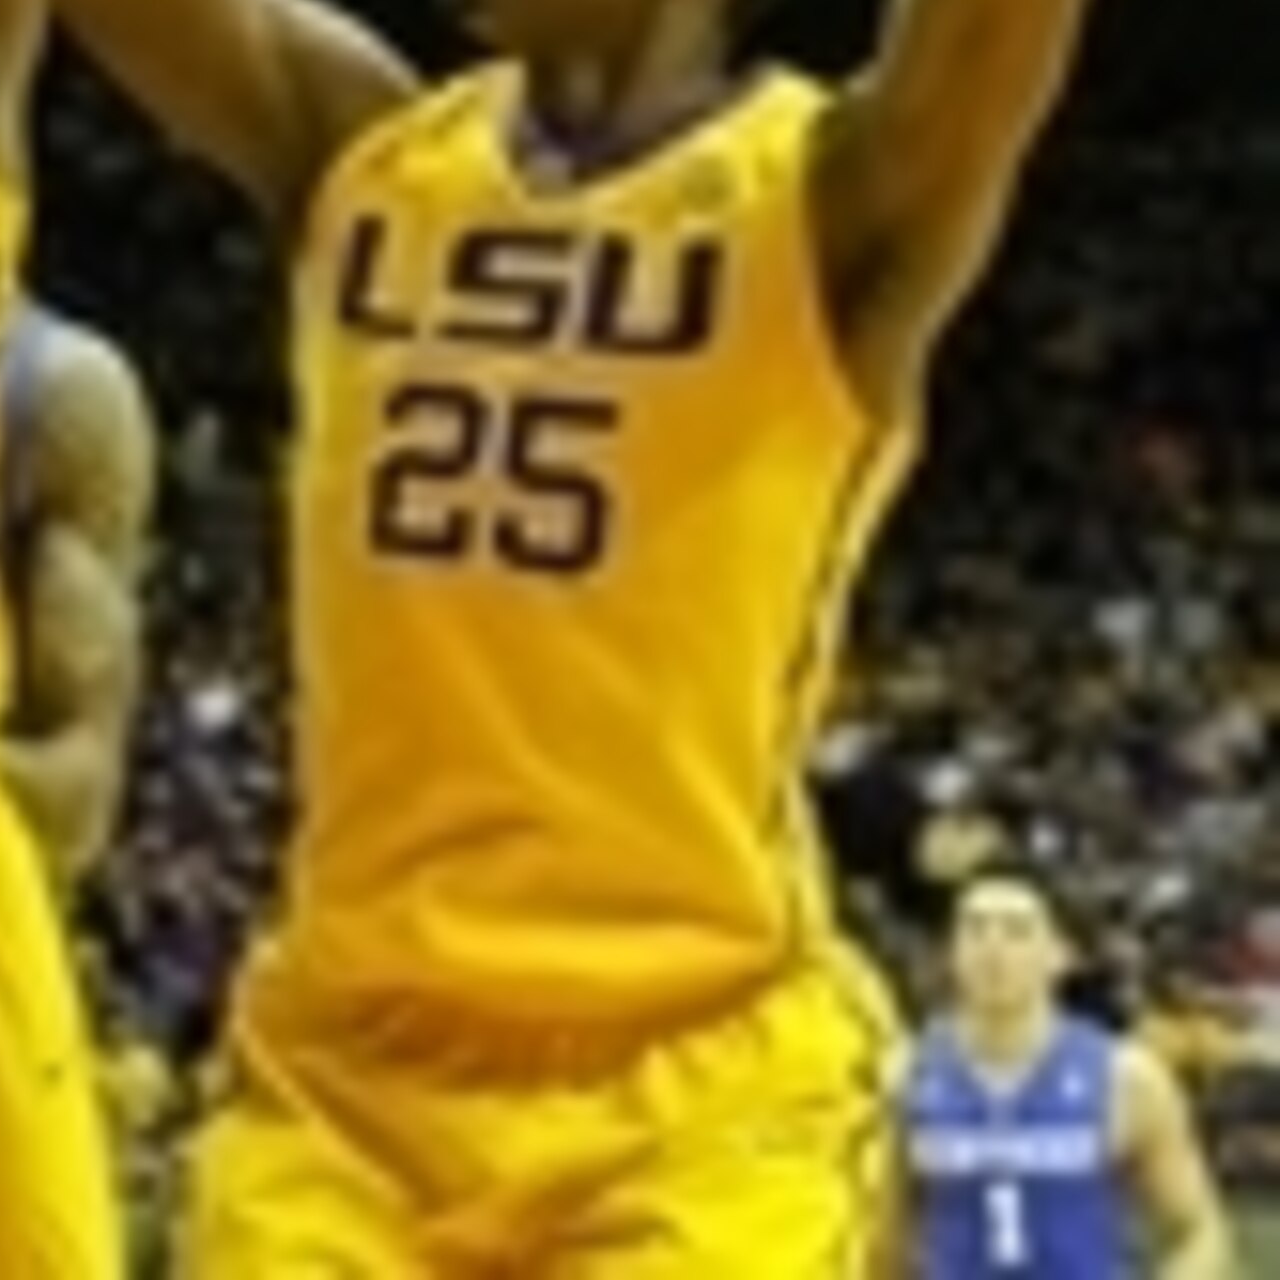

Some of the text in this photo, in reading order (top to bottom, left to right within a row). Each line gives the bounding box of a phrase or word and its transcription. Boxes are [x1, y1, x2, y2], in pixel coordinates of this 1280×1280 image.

[338, 214, 726, 360] LSU
[368, 382, 622, 578] 25
[985, 1182, 1028, 1265] 1
